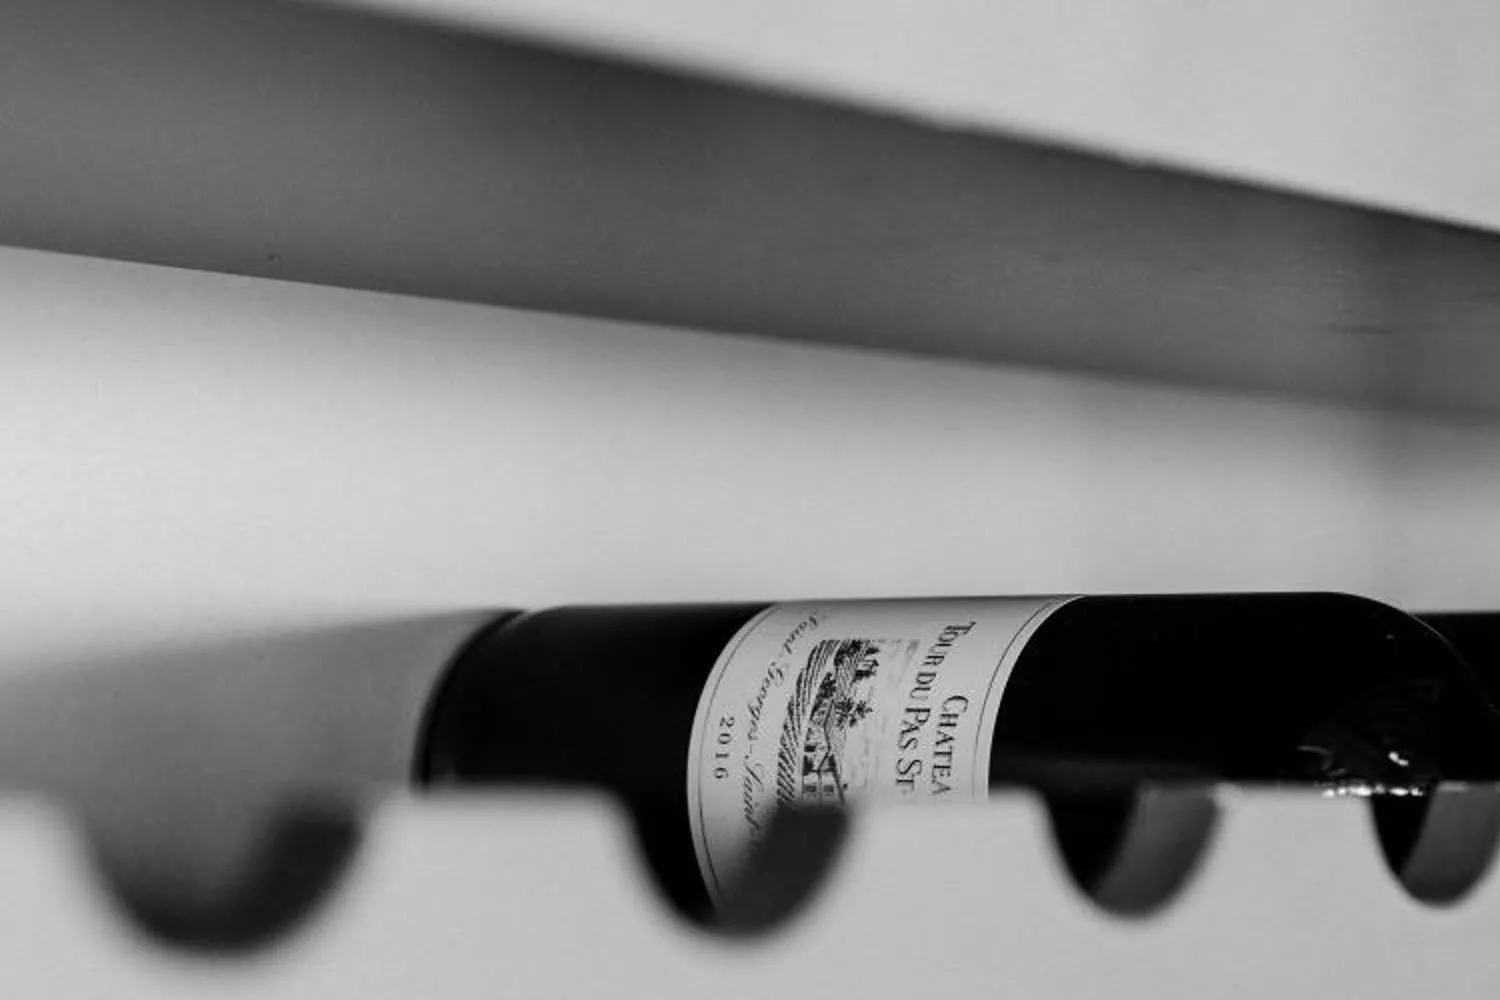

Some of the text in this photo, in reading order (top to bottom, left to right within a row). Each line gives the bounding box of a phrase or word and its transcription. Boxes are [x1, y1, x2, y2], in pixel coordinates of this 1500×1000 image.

[923, 621, 977, 667] TOUR
[910, 671, 936, 702] DU
[713, 716, 736, 780] 2016
[899, 706, 931, 751] PAS
[931, 695, 969, 797] CHATEA
